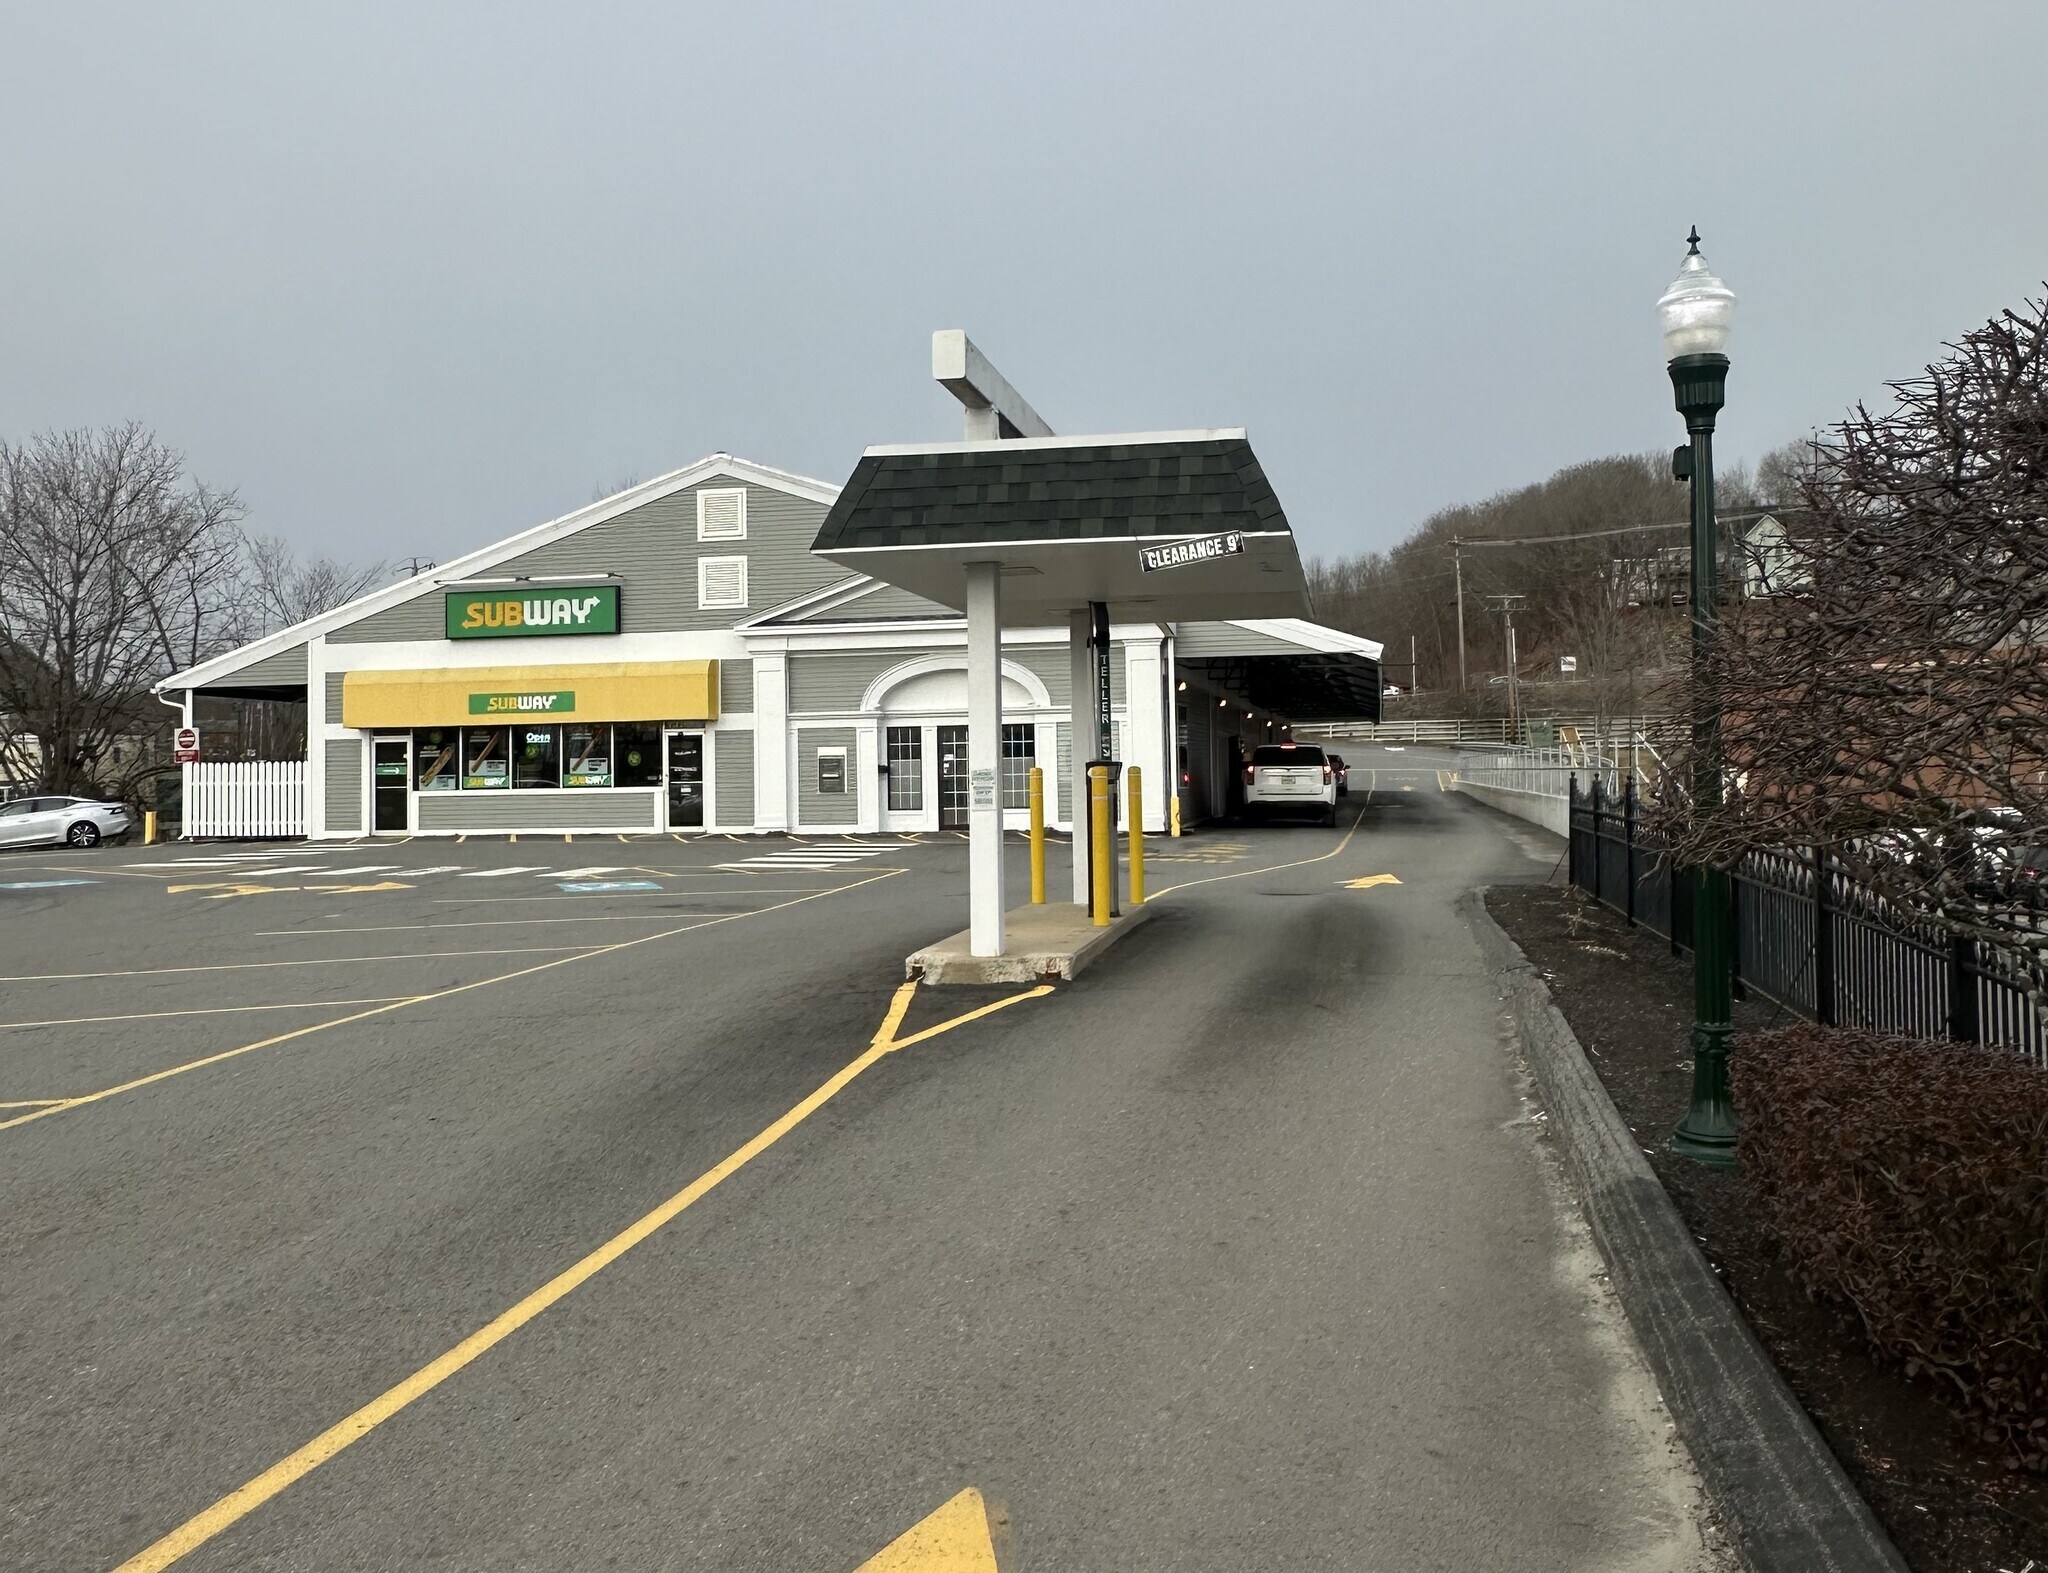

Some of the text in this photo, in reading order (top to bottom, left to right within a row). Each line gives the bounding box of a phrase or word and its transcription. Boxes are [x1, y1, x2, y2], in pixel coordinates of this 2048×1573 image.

[1147, 538, 1223, 568] CLEARANCE
[461, 595, 601, 629] SUBWAY
[487, 695, 557, 711] SUBWAY
[1099, 654, 1110, 724] TELLER
